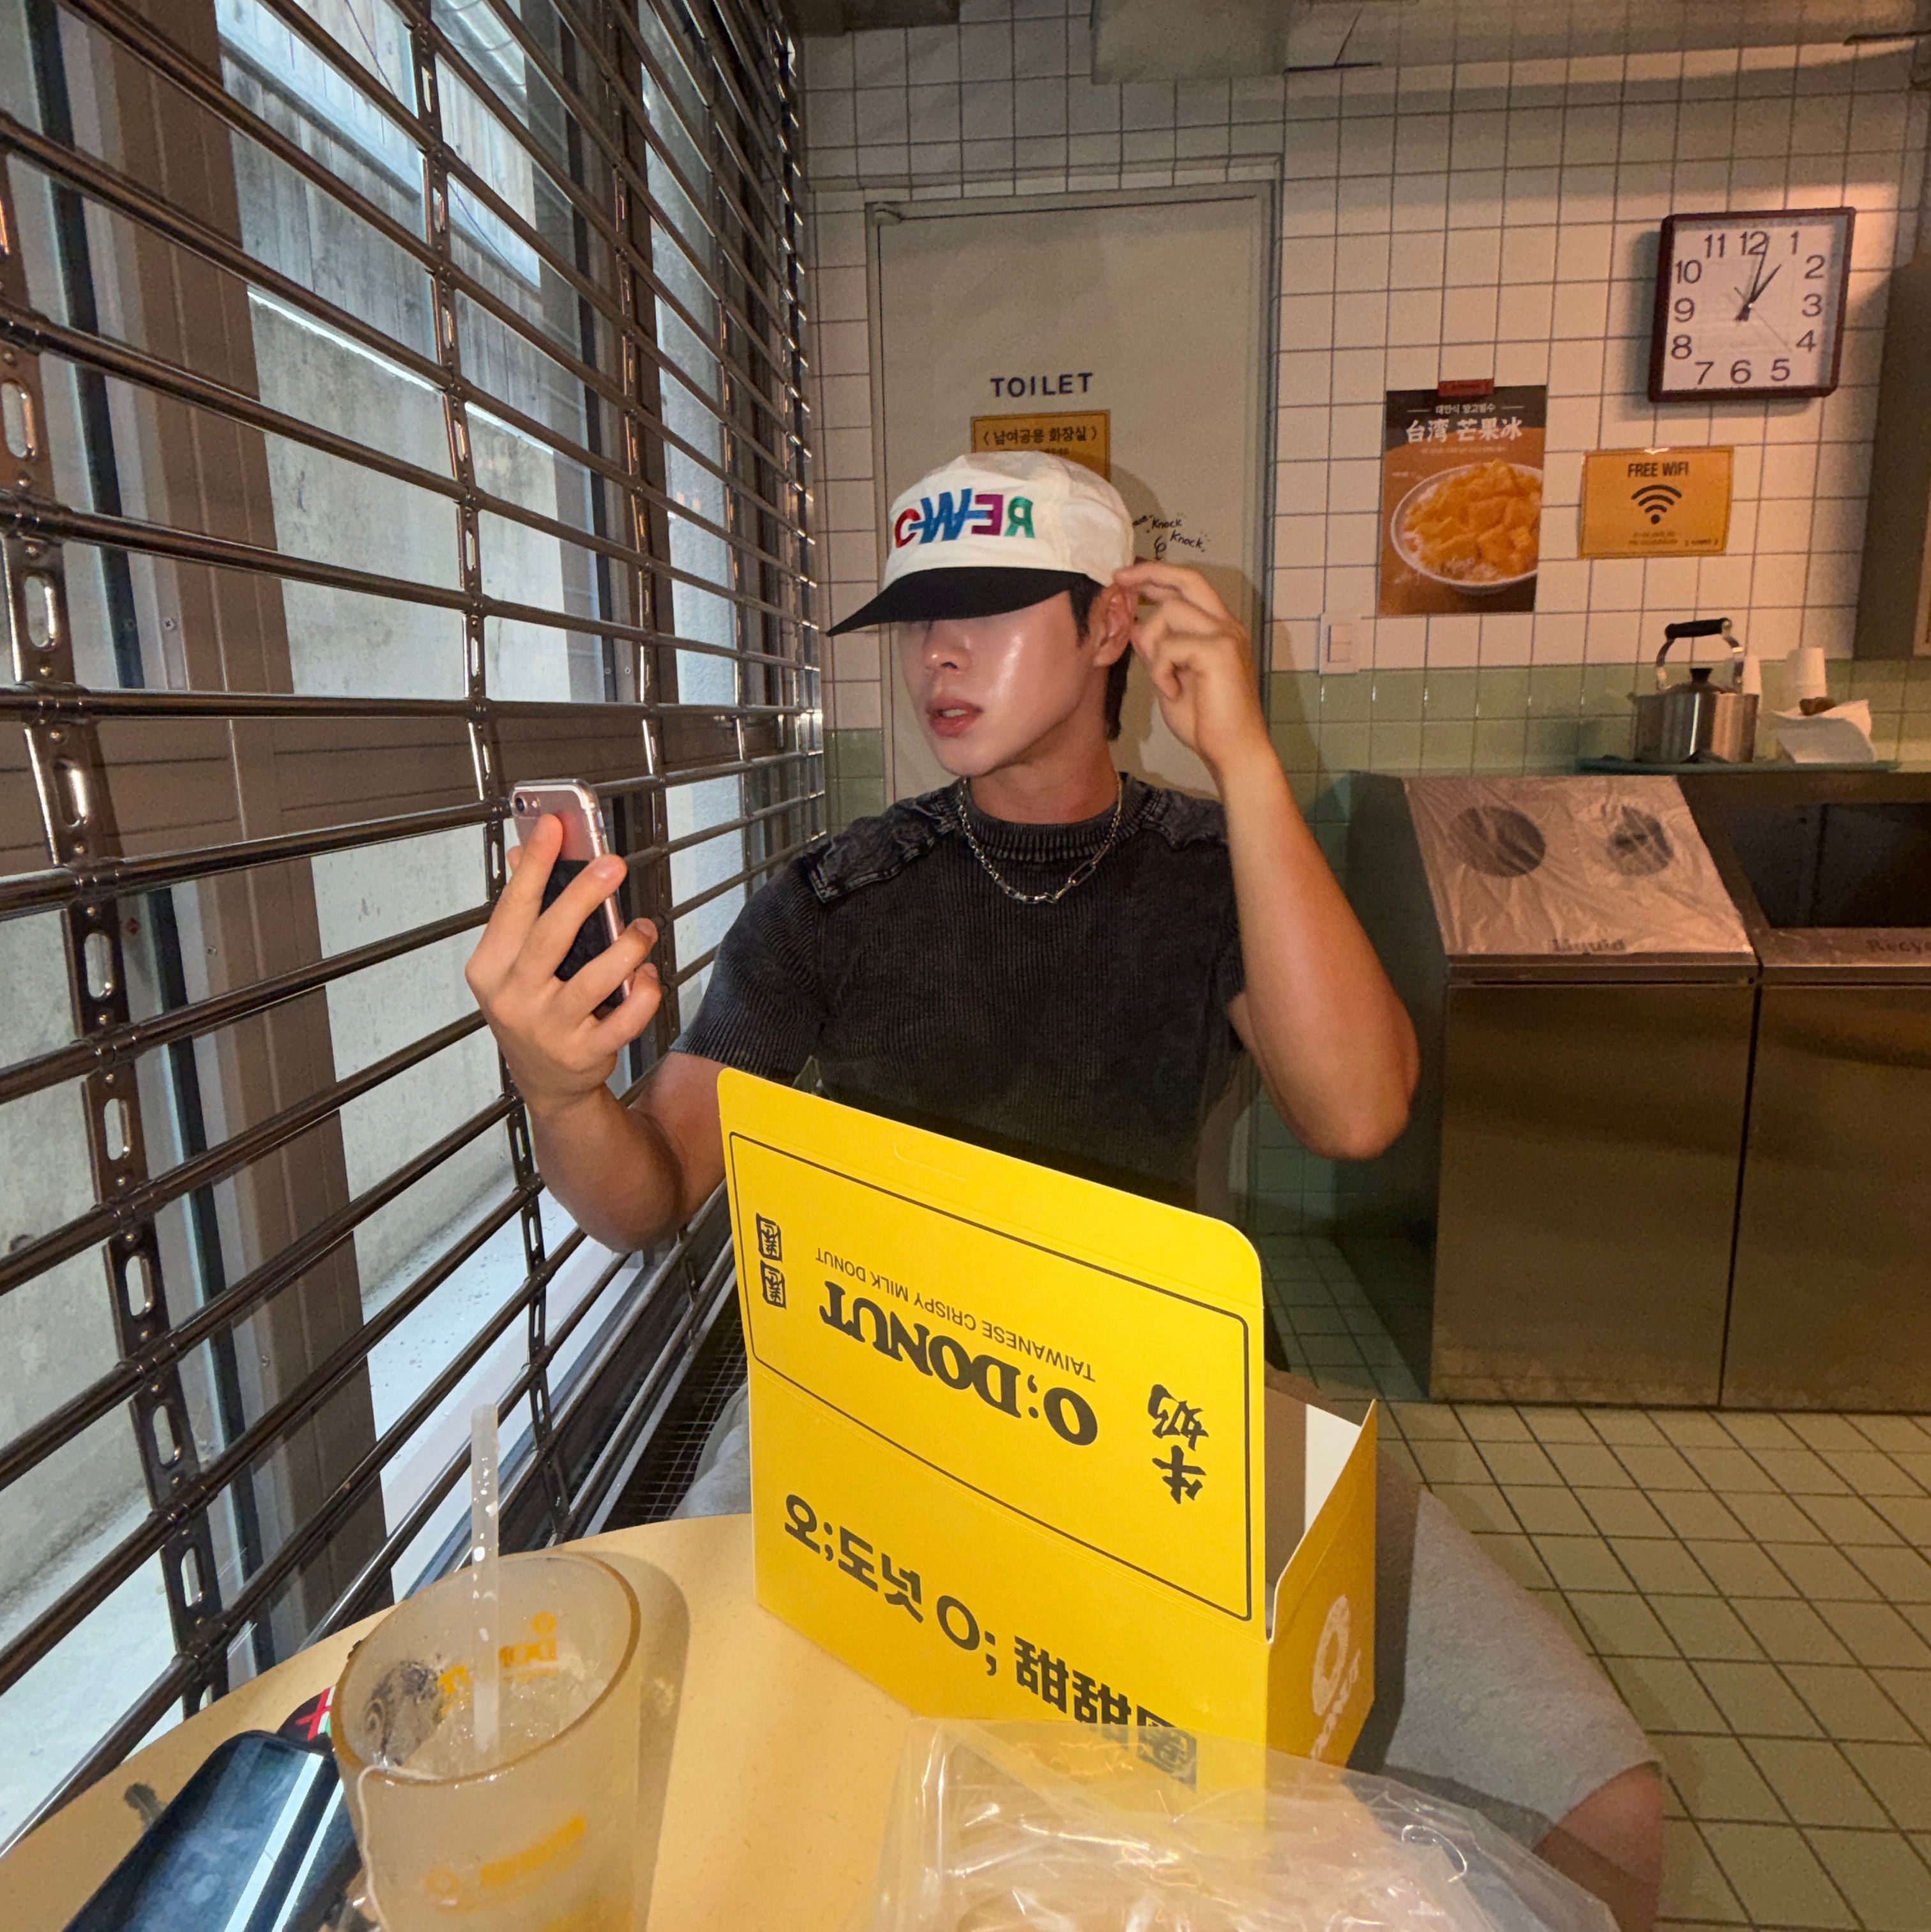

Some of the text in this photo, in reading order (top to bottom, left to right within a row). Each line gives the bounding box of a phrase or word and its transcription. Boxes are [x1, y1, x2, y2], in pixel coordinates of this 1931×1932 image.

[1704, 233, 1726, 259] 11
[1739, 231, 1768, 256] 12
[1791, 231, 1799, 255] 1
[1675, 259, 1702, 284] 10
[1804, 254, 1826, 280] 2
[1674, 298, 1695, 323] 9
[1801, 293, 1822, 317] 3
[1671, 335, 1692, 360] 8
[1795, 330, 1817, 352] 4
[1694, 361, 1714, 385] 7
[1730, 360, 1751, 384] 6
[1770, 358, 1790, 381] 5
[990, 372, 1093, 398] TOILET
[994, 429, 1045, 445] 남여공용
[1049, 426, 1087, 442] 화장실
[1457, 416, 1523, 442] 芒果冰
[1628, 461, 1690, 478] FREE WIFI
[1151, 517, 1181, 529] Knock
[1170, 529, 1203, 549] Knock
[816, 1247, 1096, 1383] TAIWANESE CRISPY MILK DONUT
